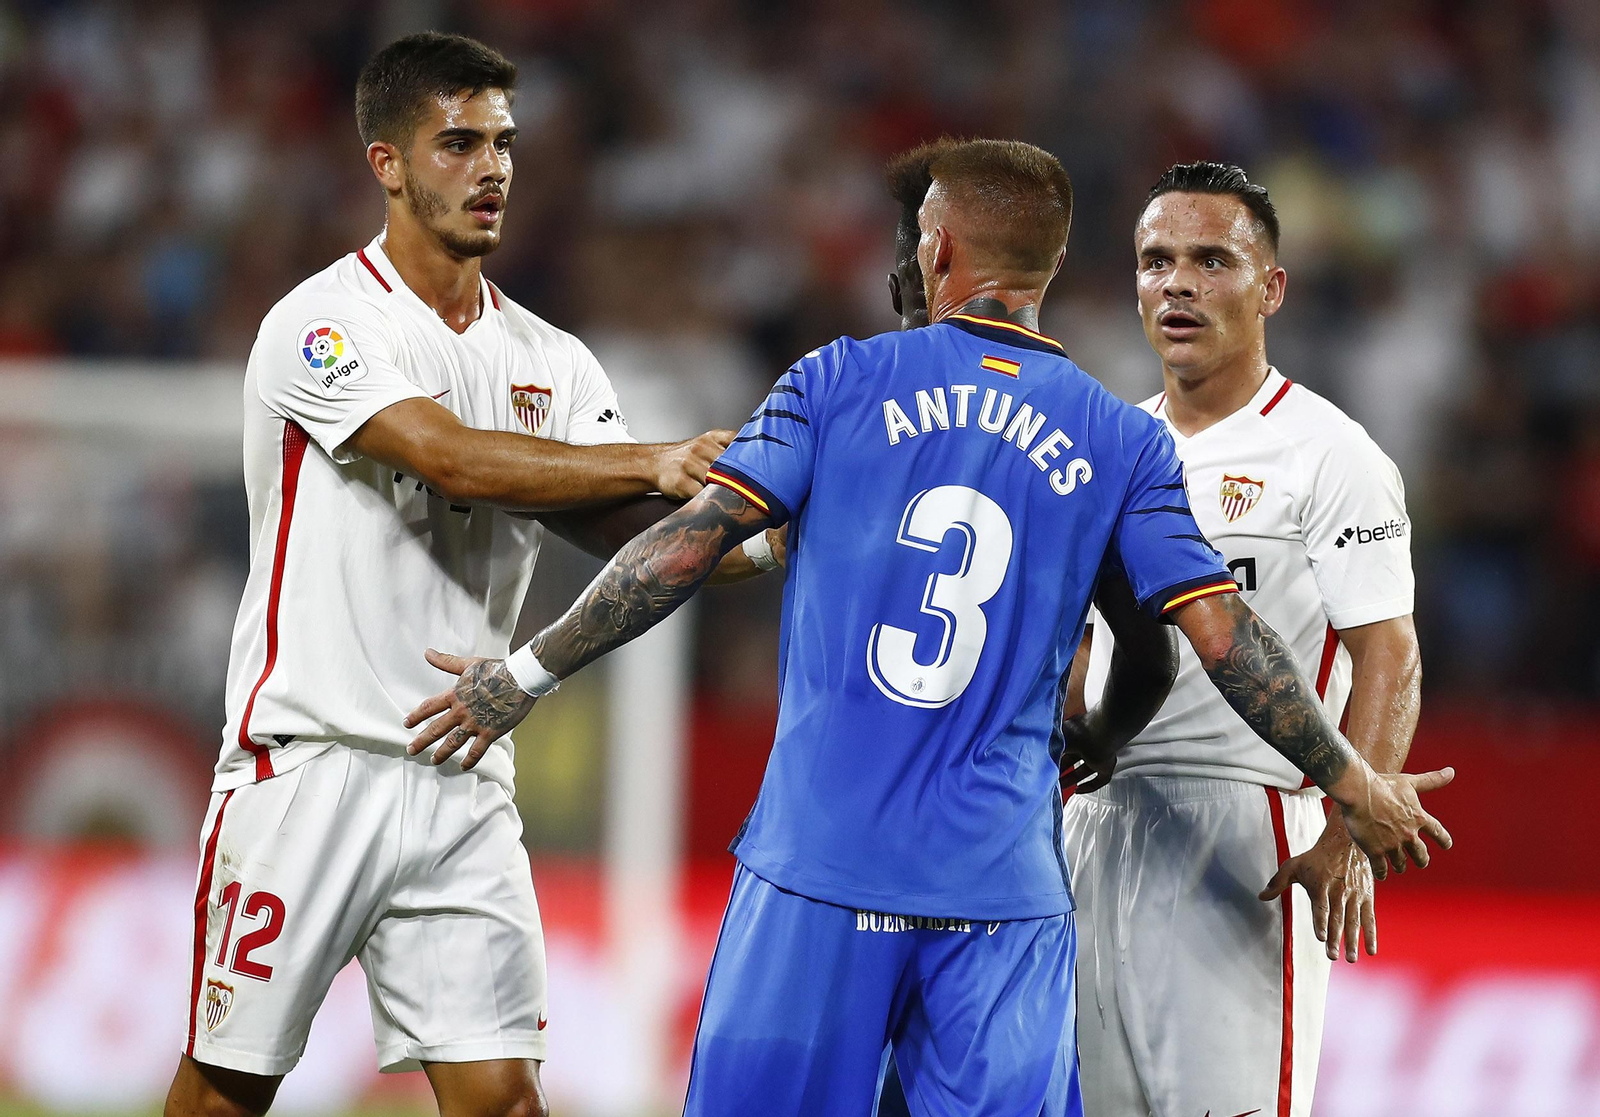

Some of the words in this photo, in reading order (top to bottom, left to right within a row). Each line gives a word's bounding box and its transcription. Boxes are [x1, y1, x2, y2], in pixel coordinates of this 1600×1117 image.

[321, 360, 359, 389] LaLiga
[882, 384, 1093, 496] ANTUNES
[1356, 518, 1406, 544] betfair
[866, 485, 1013, 710] 3
[214, 881, 286, 983] 12
